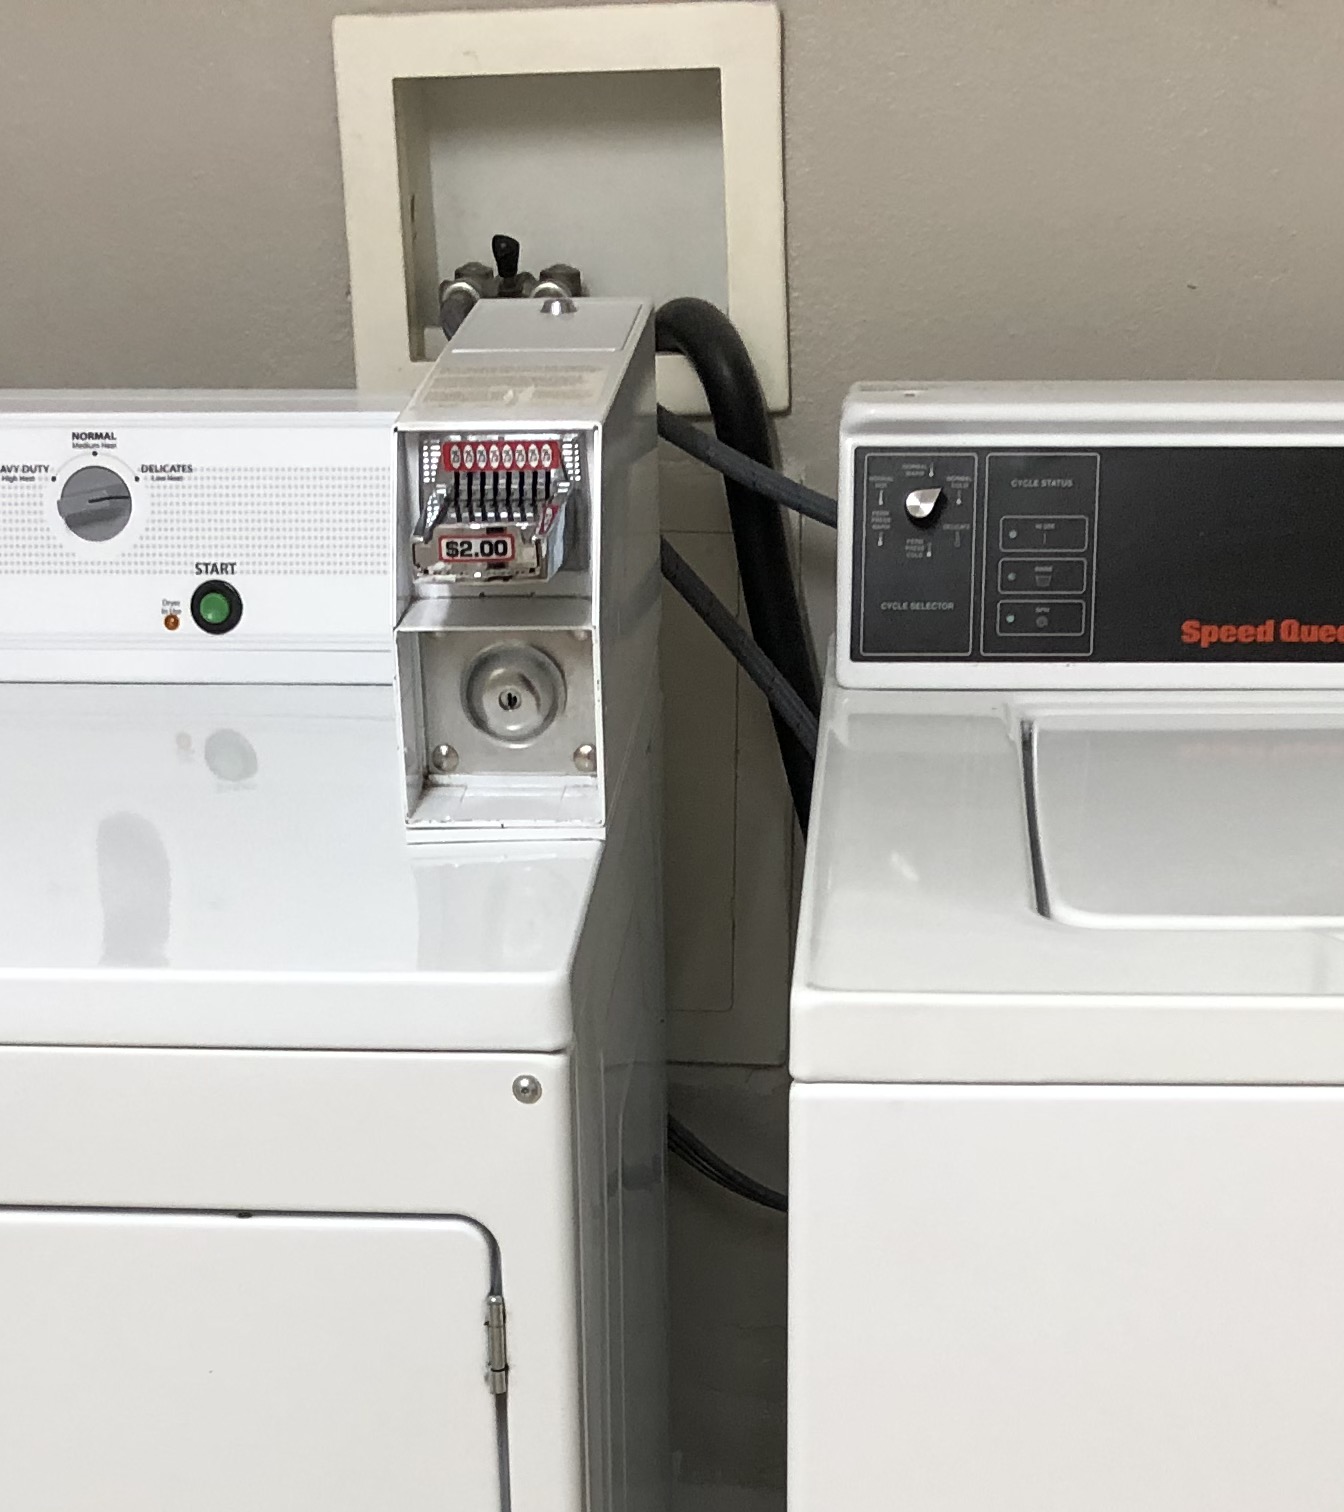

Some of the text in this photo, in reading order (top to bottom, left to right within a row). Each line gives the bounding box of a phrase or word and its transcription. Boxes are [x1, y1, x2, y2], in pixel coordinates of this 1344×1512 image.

[72, 432, 116, 441] NORMAL
[22, 465, 49, 473] DUTY
[141, 464, 193, 473] DELICATES
[1011, 479, 1073, 487] CYCLE STATUS
[446, 540, 508, 558] $2.00
[195, 562, 237, 575] START
[881, 602, 954, 610] CYCLE SELECTOR
[1181, 619, 1274, 648] Speed
